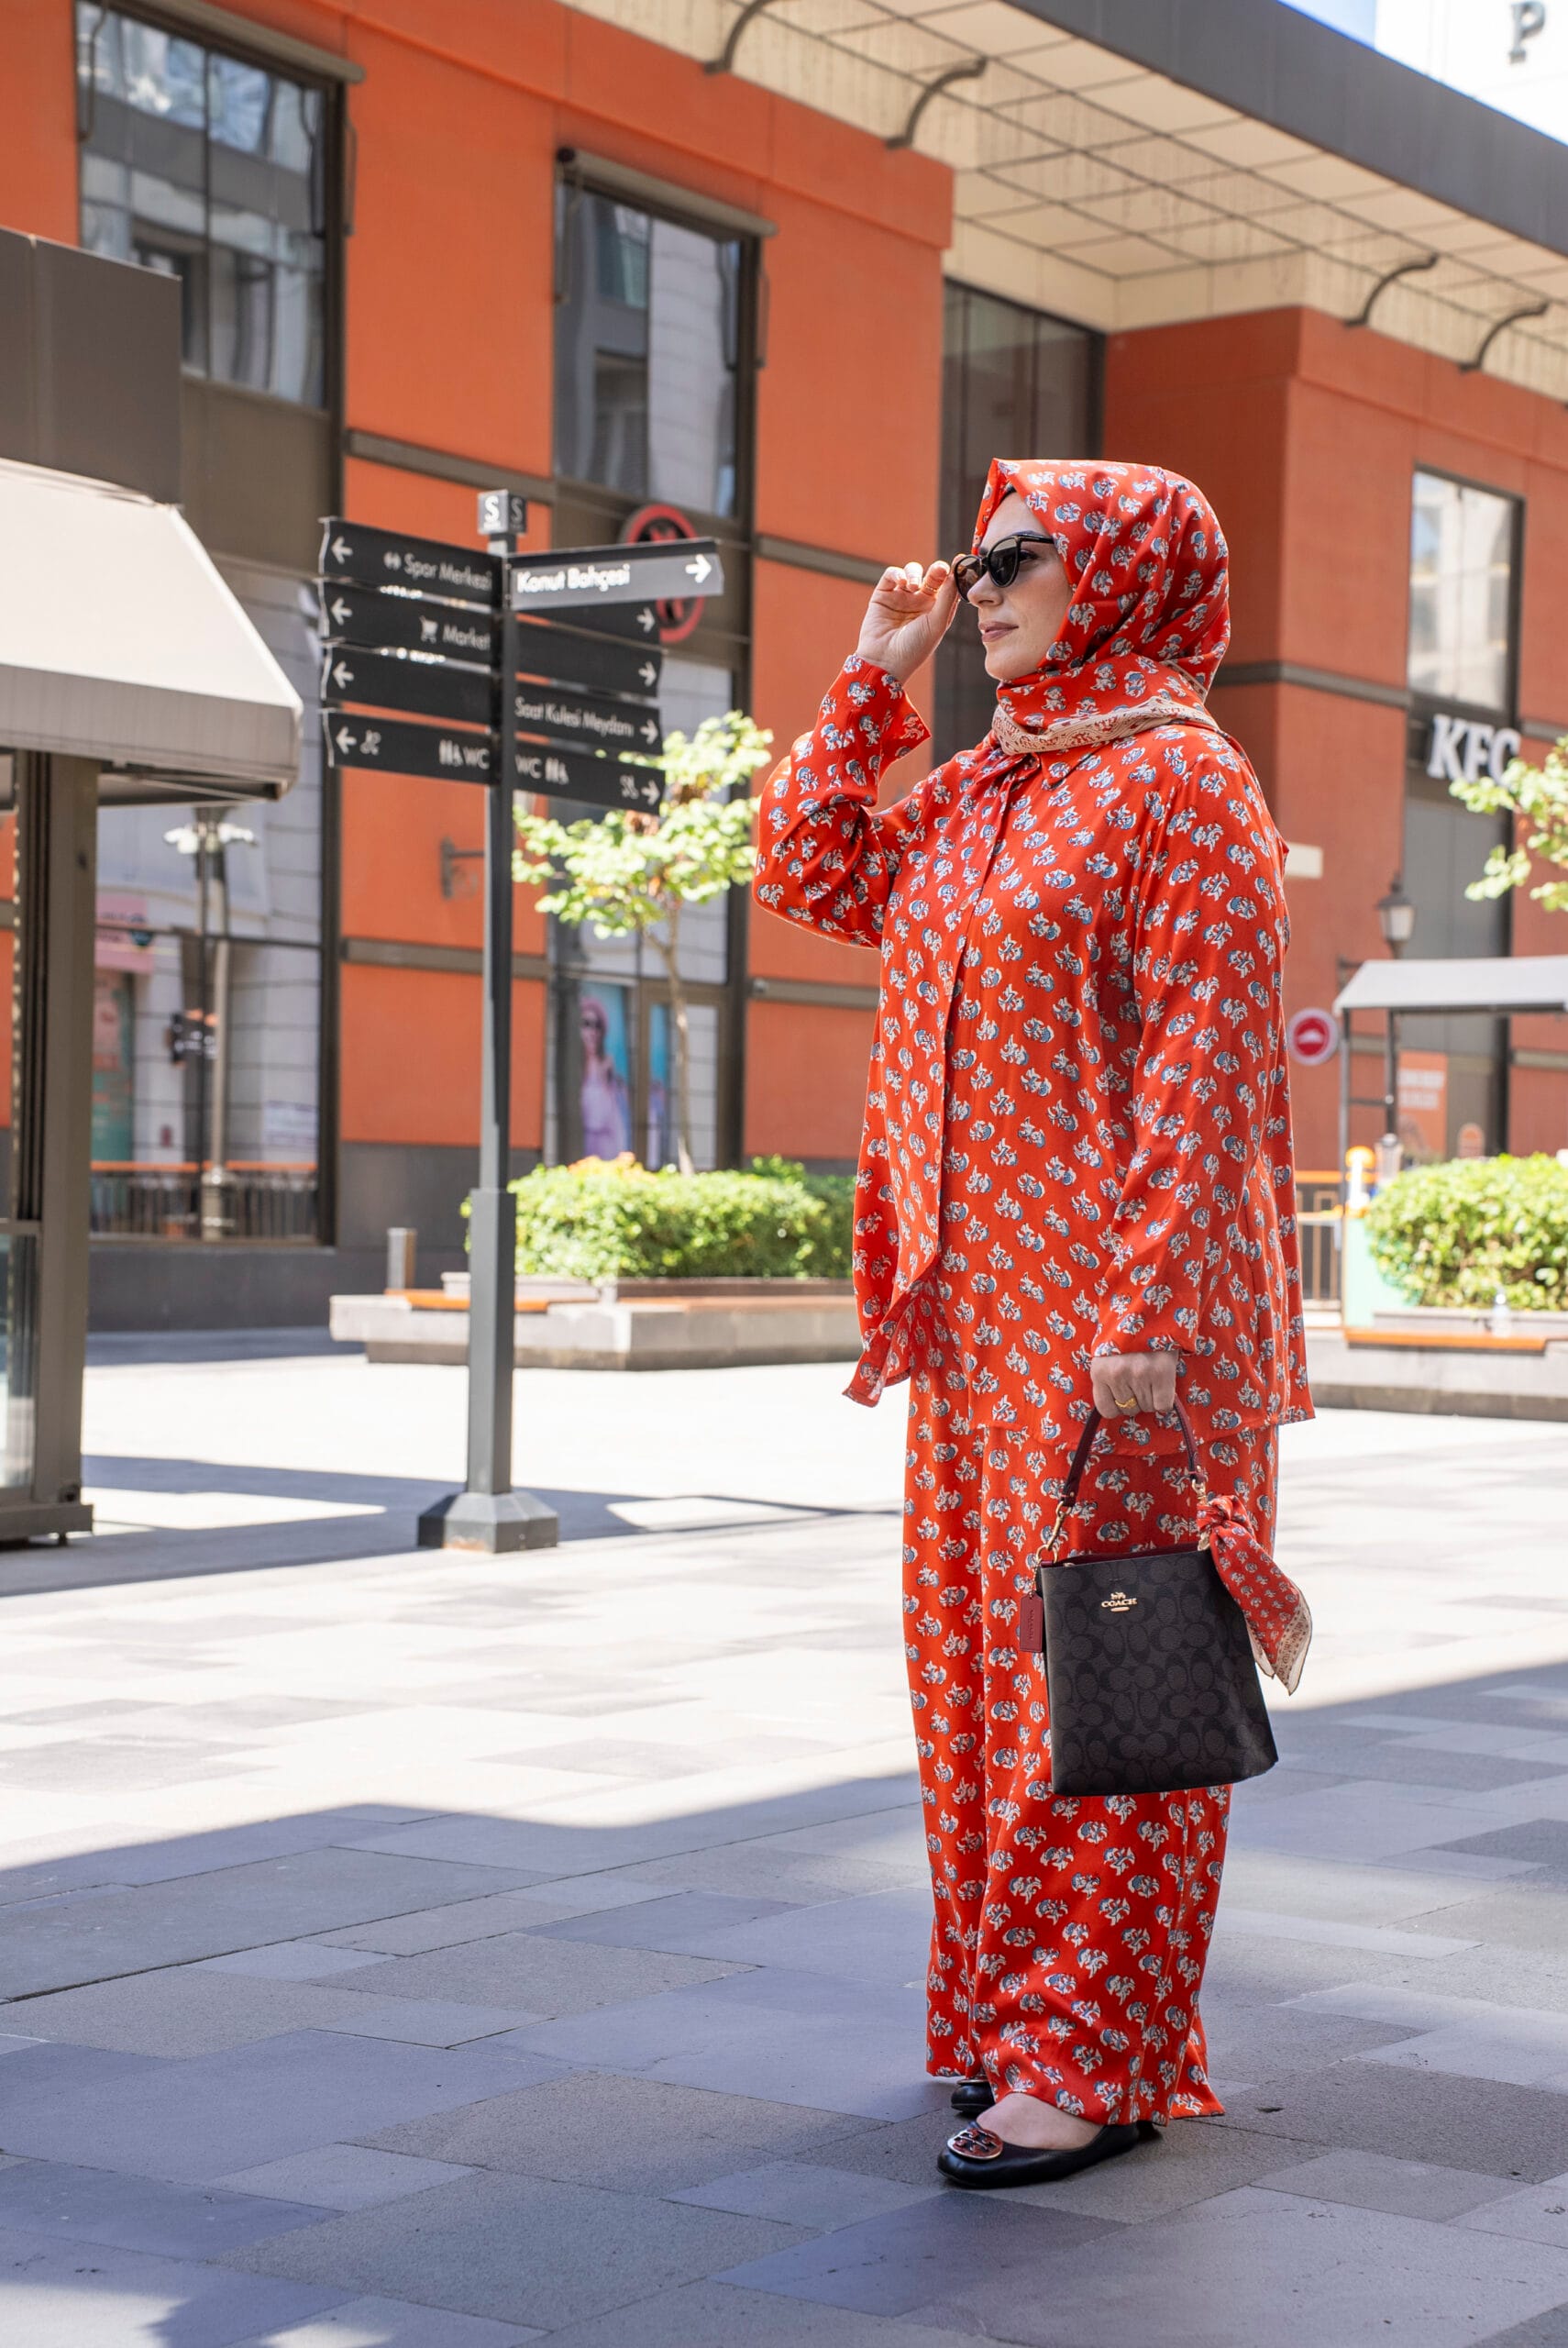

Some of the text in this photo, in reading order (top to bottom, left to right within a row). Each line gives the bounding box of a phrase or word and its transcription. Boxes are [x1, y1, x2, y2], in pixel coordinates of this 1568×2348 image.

[1507, 1, 1545, 65] P
[484, 494, 500, 522] S
[403, 552, 492, 592] Spor Merkezi
[516, 570, 566, 593] Konut
[442, 624, 491, 651] Market
[513, 695, 545, 720] Saat
[545, 703, 582, 728] Kulesi
[462, 746, 490, 770] WC
[1426, 713, 1521, 789] KFC
[514, 754, 543, 780] WC
[1101, 1598, 1138, 1608] COACH
